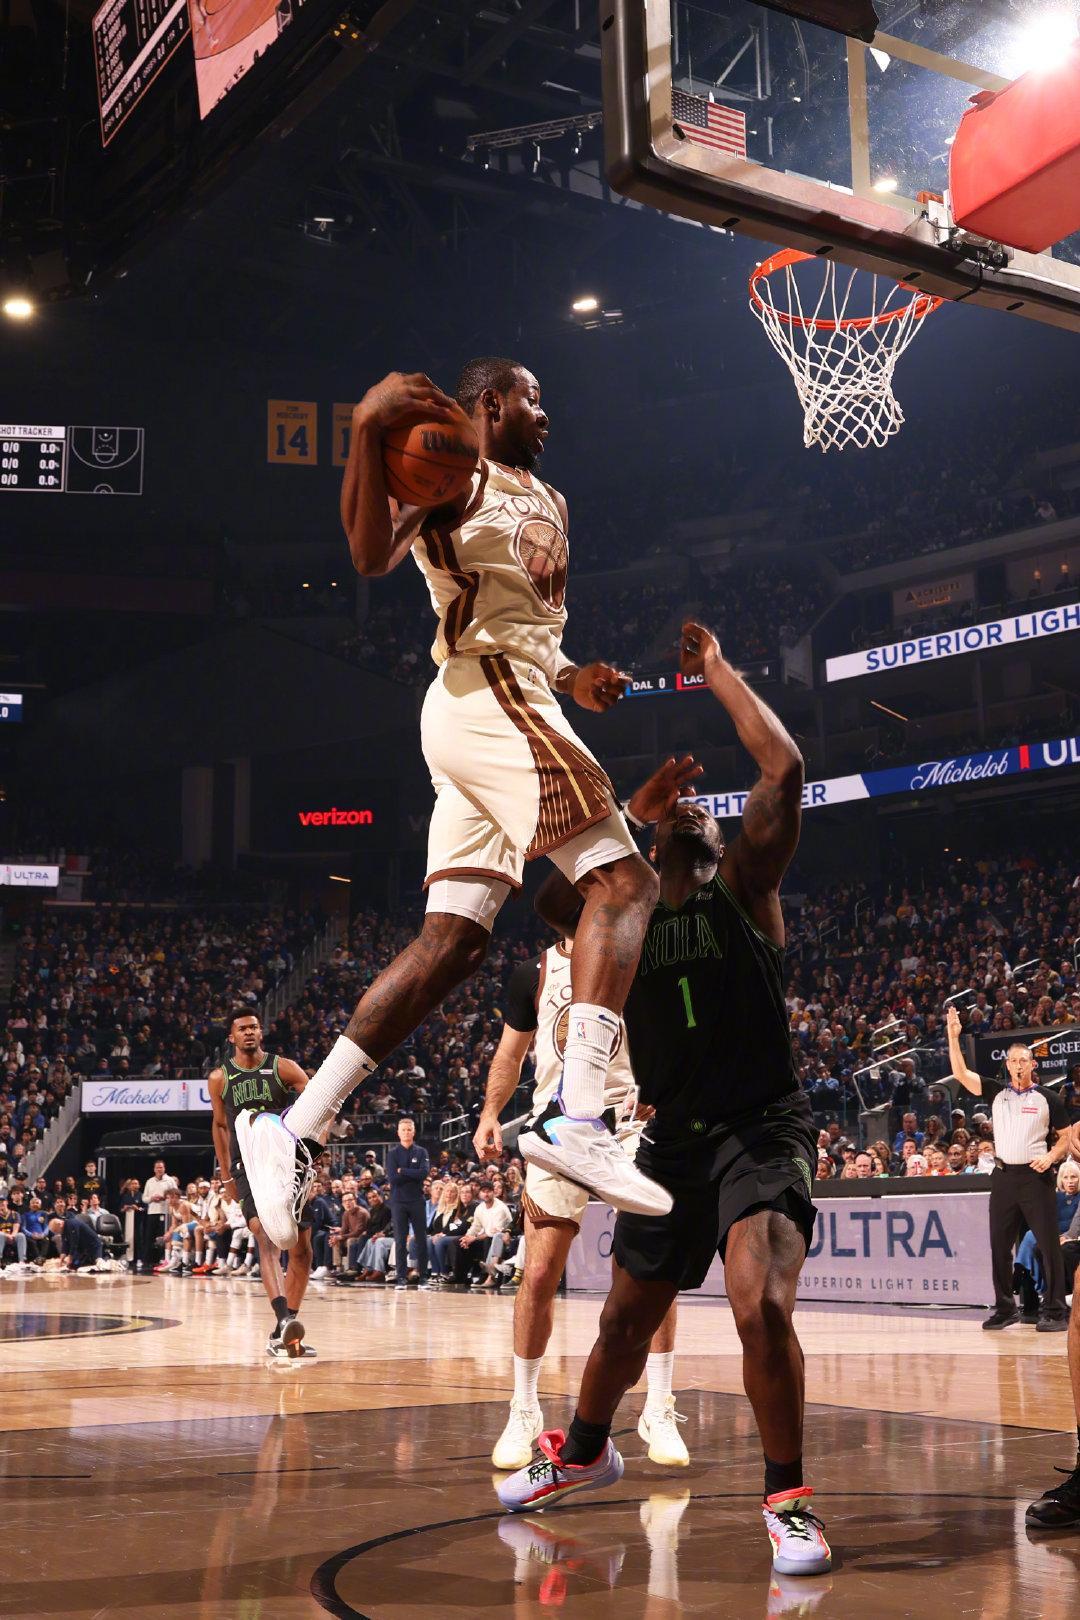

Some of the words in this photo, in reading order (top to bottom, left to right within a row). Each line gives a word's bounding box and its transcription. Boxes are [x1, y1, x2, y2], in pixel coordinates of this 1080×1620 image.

[0, 427, 16, 435] HOT
[18, 427, 53, 436] TRACKER
[276, 424, 308, 457] 14
[2, 442, 20, 453] 0/0
[341, 427, 351, 459] 1
[1, 458, 19, 469] 0/0
[0, 474, 18, 485] 0/0
[866, 623, 1003, 671] SUPERIOR
[1014, 605, 1080, 639] LIGH
[632, 681, 653, 691] DAL
[658, 677, 666, 689] 0
[683, 674, 704, 685] LAC
[910, 752, 1009, 790] Michelob
[686, 793, 748, 816] GHT
[801, 783, 827, 806] ER
[299, 807, 373, 826] verizon
[14, 871, 49, 880] ULTRA
[640, 912, 723, 976] NOLA
[678, 977, 697, 1028] 1
[1041, 1059, 1068, 1069] RESORT
[92, 1086, 170, 1107] Michelob
[232, 1078, 273, 1107] NOLA
[140, 1132, 182, 1144] Rakuten
[806, 1210, 954, 1258] ULTRA
[870, 1278, 913, 1290] LIGHT
[923, 1279, 960, 1291] BEER
